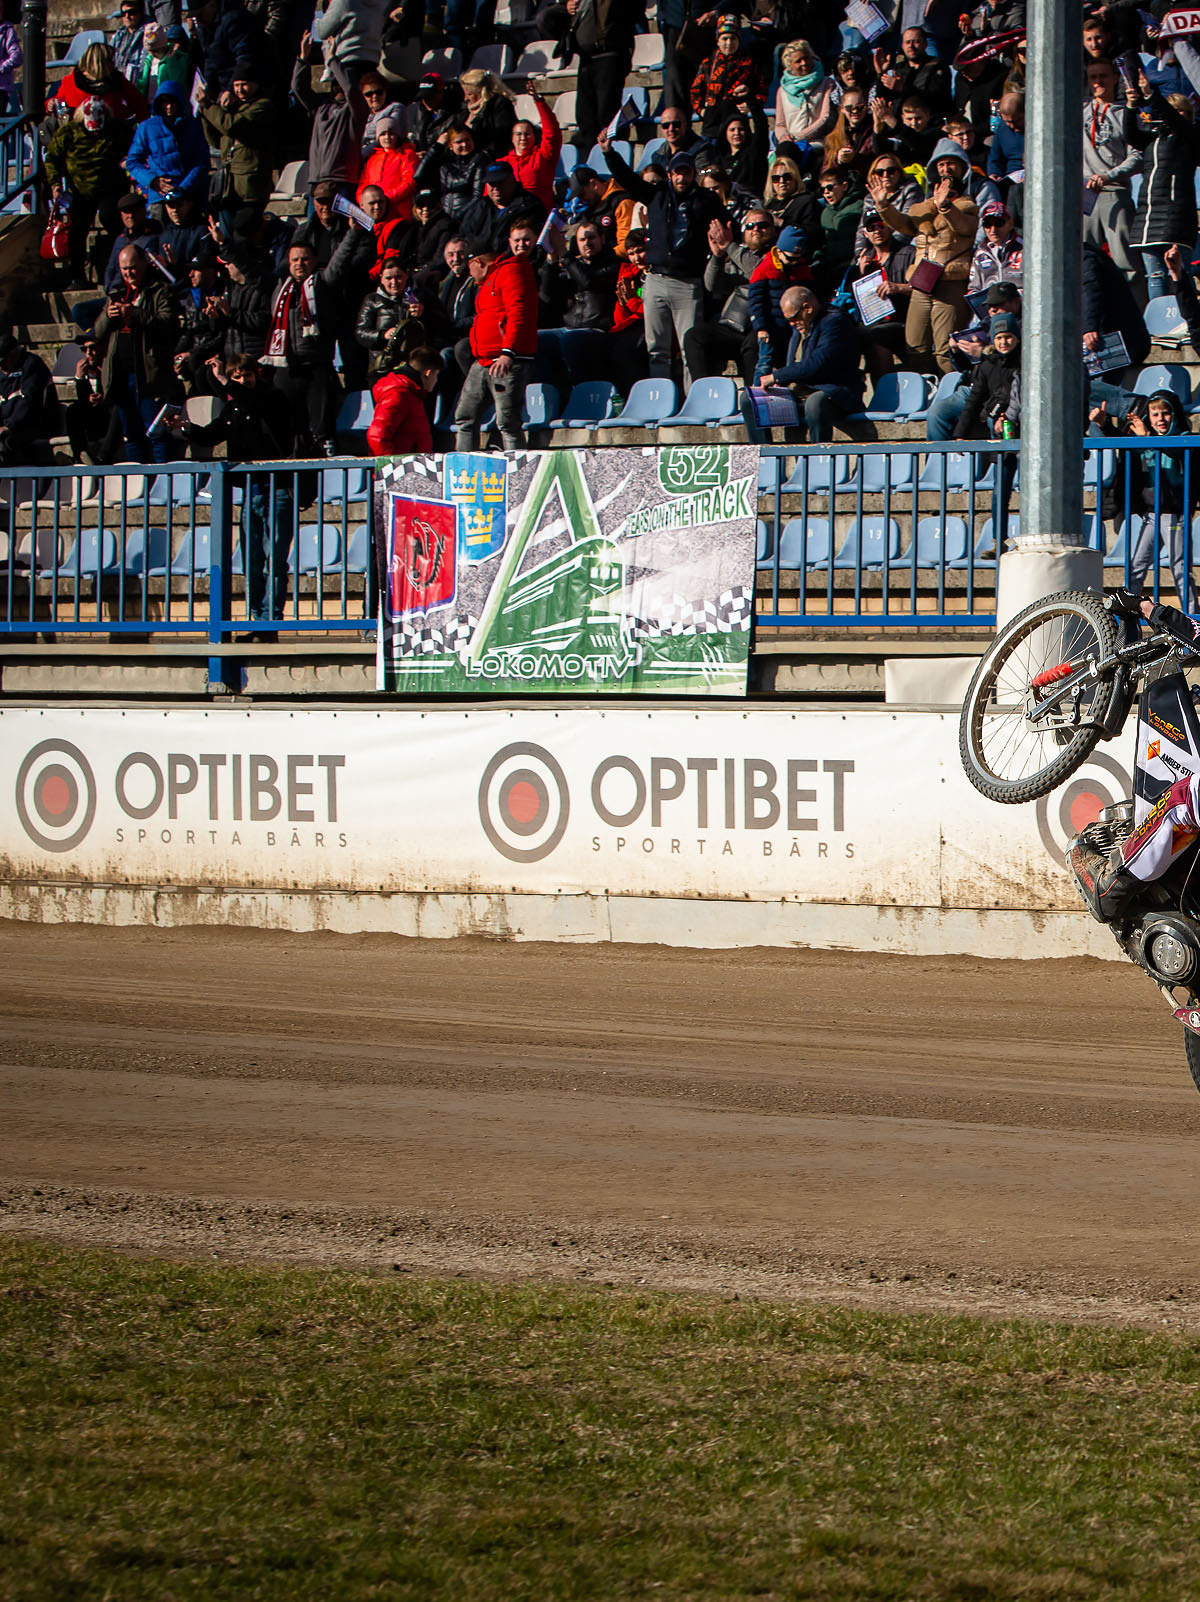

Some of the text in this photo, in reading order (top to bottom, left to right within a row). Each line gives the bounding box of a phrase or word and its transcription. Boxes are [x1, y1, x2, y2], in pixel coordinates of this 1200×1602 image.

[1165, 306, 1177, 318] 20
[667, 446, 721, 486] 52
[651, 506, 665, 532] ON
[667, 498, 689, 528] THE
[692, 479, 749, 525] TRACK
[466, 654, 632, 679] LOKOMOTIV
[1149, 718, 1180, 742] LONDON
[1160, 753, 1182, 772] AMBER
[115, 751, 346, 822] OPTIBET
[591, 755, 855, 832] OPTIBET
[116, 828, 347, 847] SPORTA BĀRS
[592, 837, 855, 858] SPORTA BĀRS
